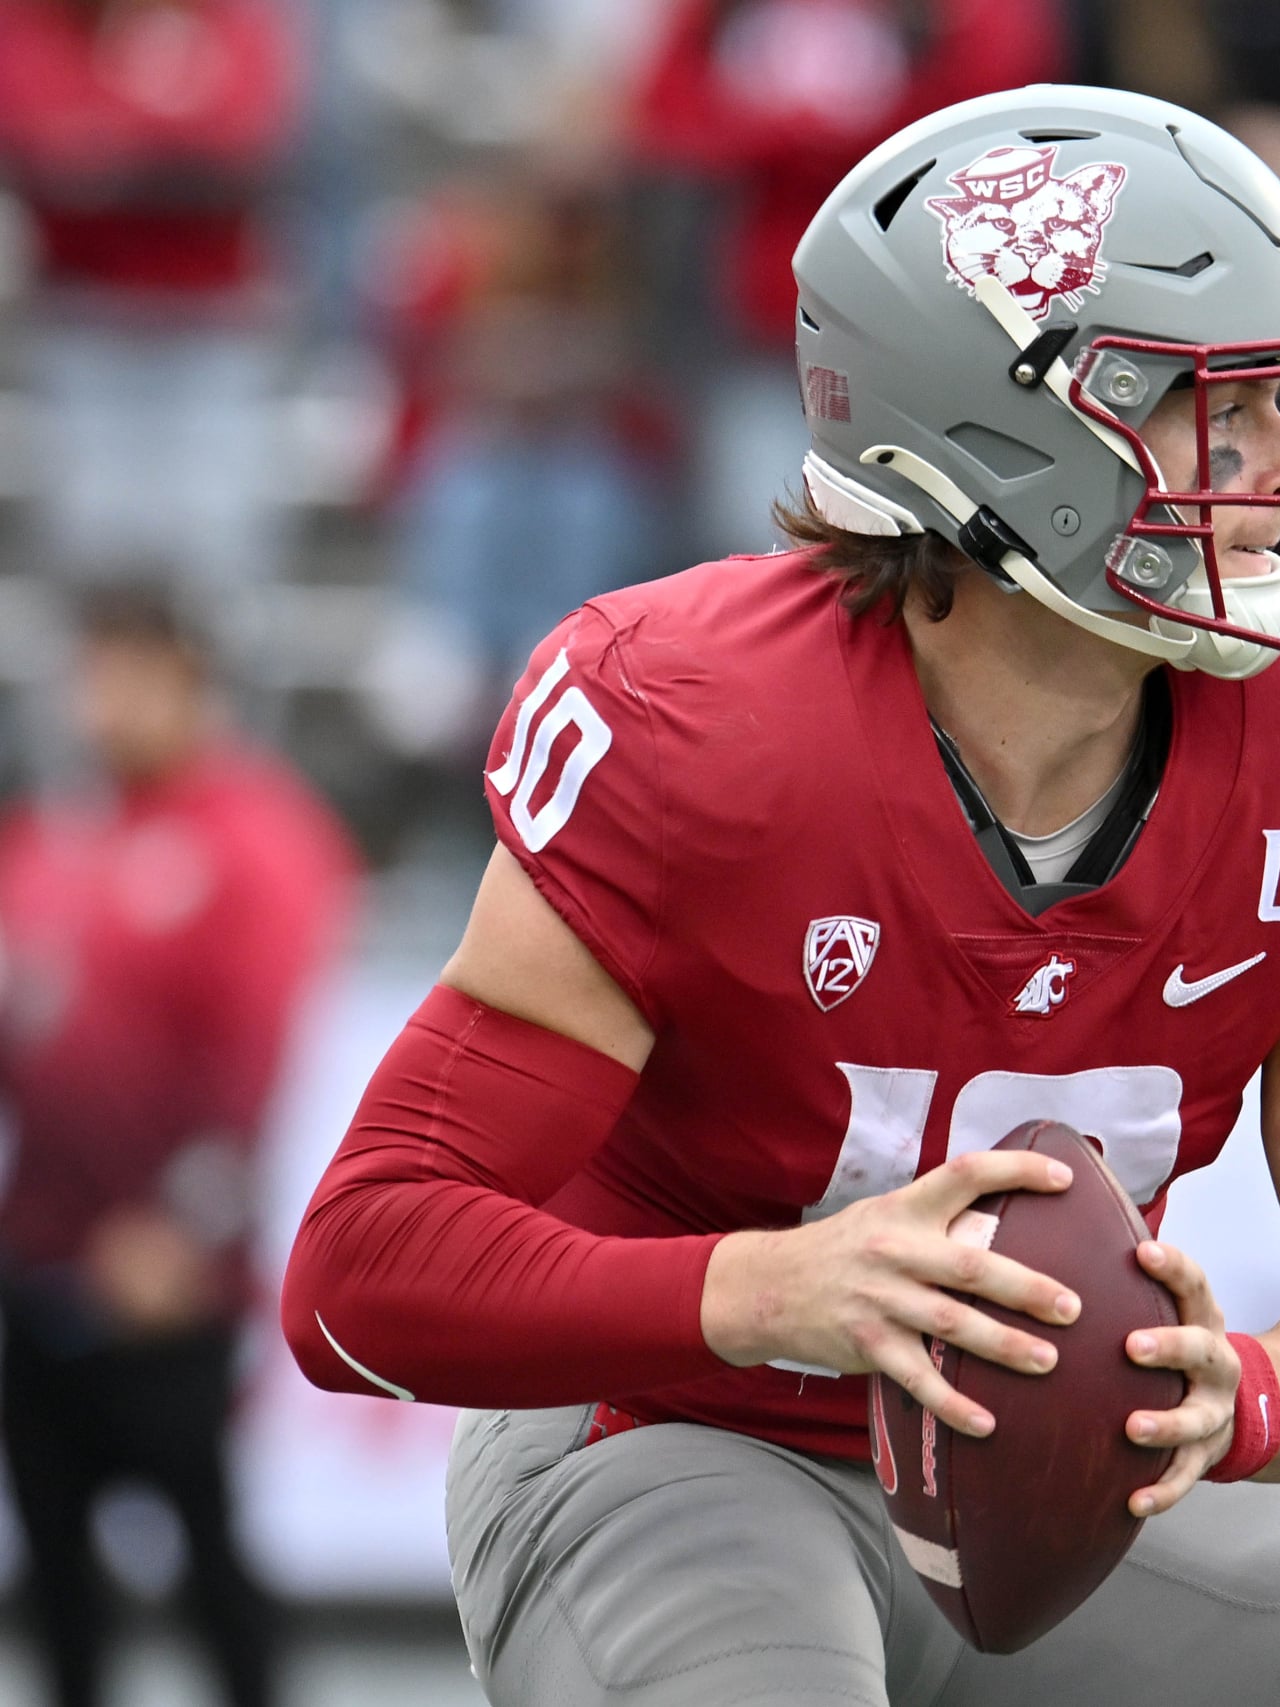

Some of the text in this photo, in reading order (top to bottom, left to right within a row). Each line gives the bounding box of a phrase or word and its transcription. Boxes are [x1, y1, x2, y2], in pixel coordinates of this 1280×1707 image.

[964, 164, 1045, 200] WSC
[489, 647, 613, 854] 10
[808, 919, 877, 977] PAC
[815, 957, 855, 992] 12
